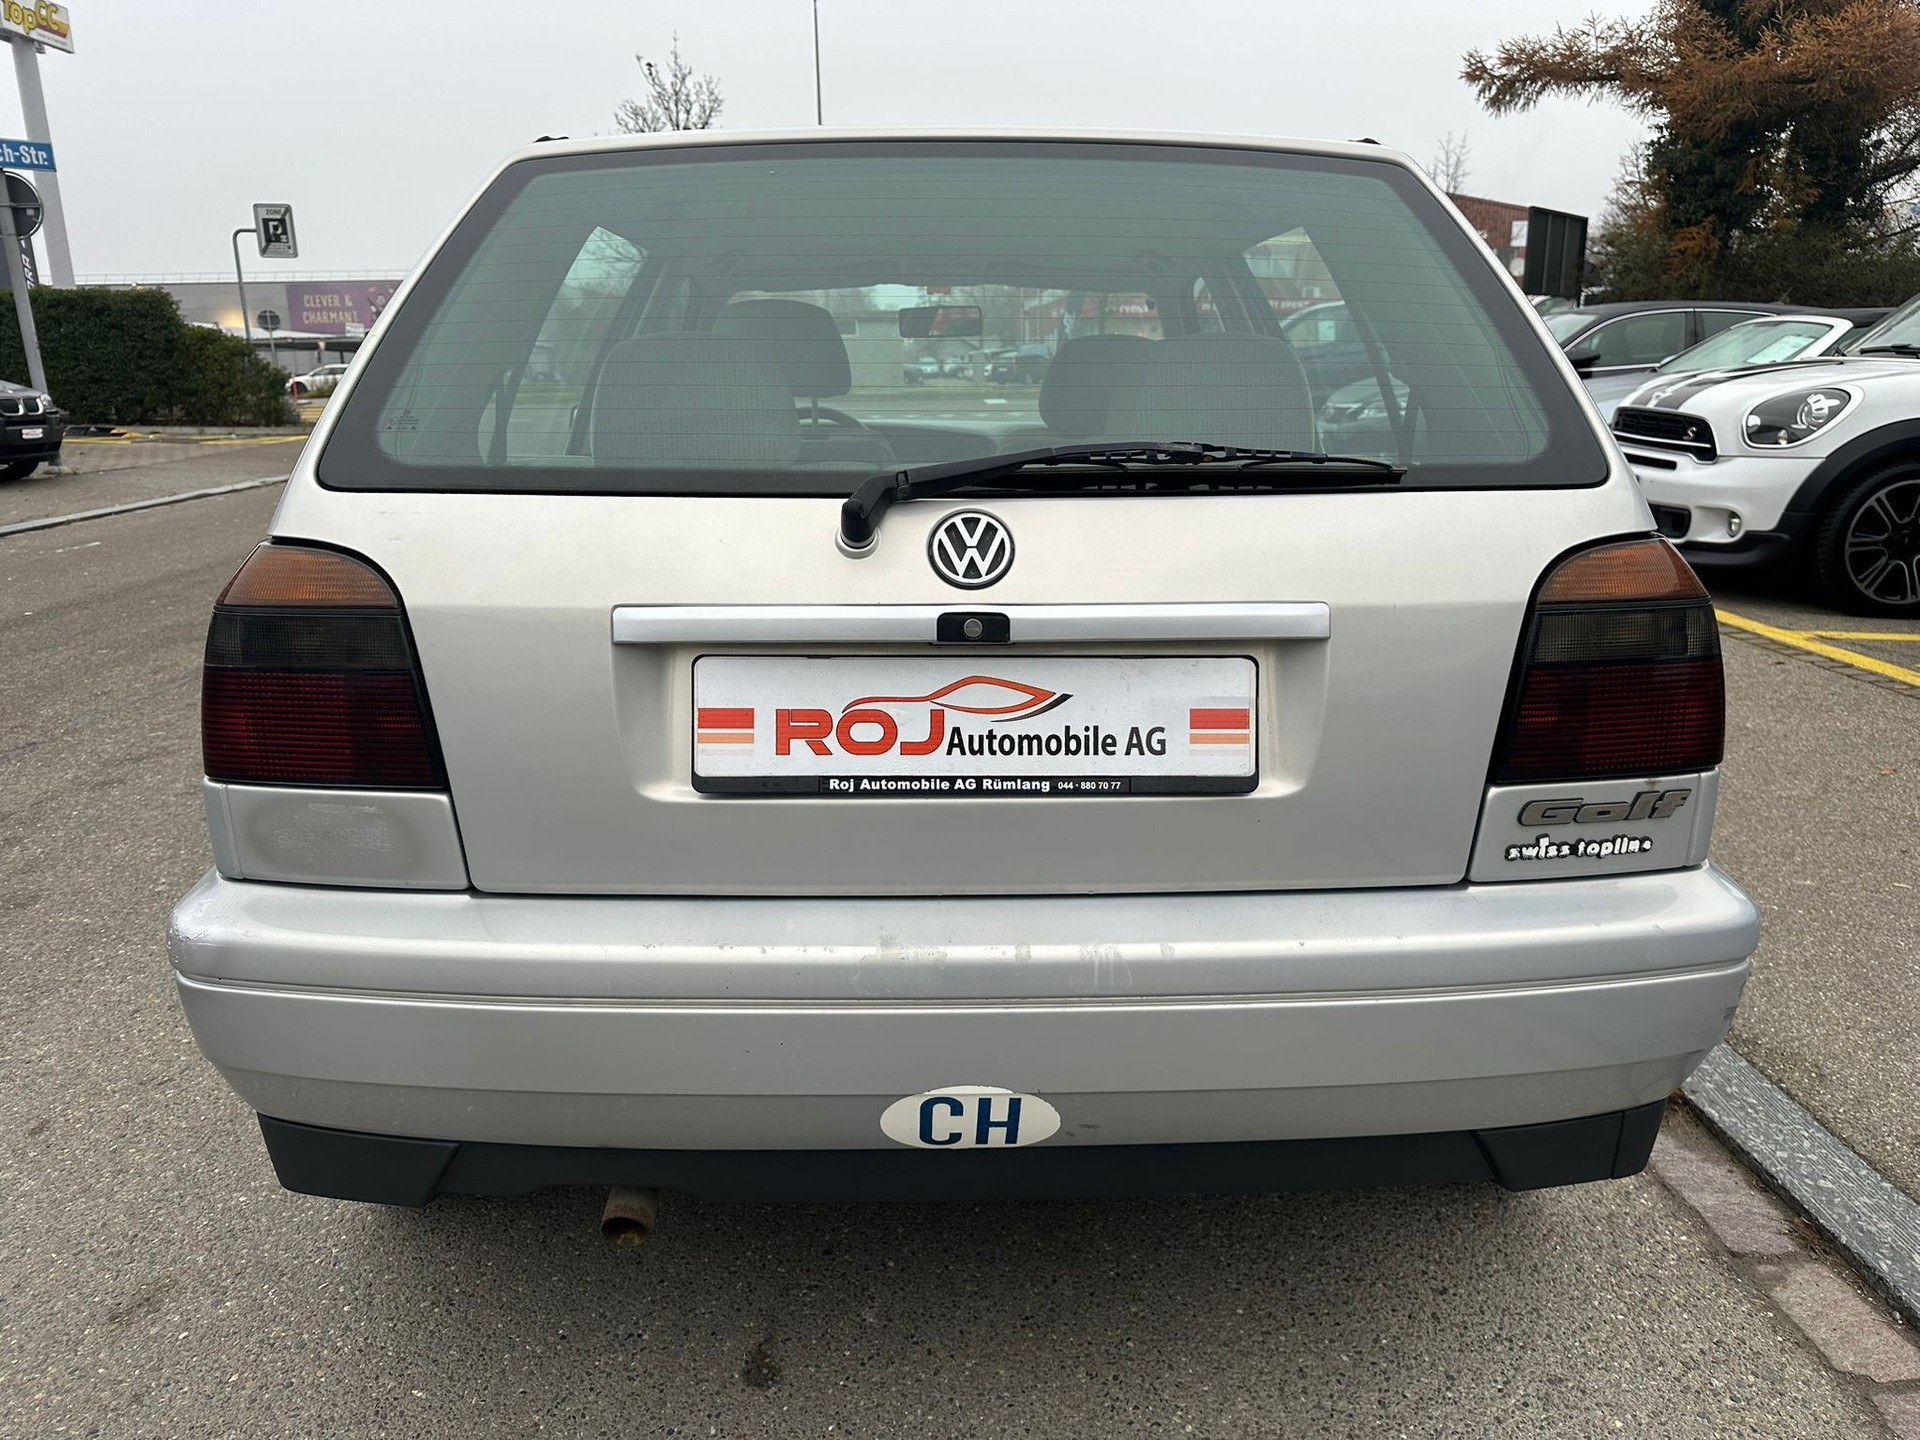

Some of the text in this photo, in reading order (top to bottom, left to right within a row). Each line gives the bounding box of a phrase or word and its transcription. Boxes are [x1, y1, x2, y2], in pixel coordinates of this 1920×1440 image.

[303, 293, 354, 307] CLEVER &
[302, 311, 358, 324] CHARMANT
[933, 513, 1011, 584] VW
[775, 709, 1167, 757] ROJ Automobile AG
[829, 778, 855, 793] Roj
[860, 778, 951, 790] Automobile
[954, 778, 977, 790] AG
[982, 778, 1051, 793] Rümlang
[1058, 781, 1074, 790] 044
[1080, 781, 1096, 790] 880
[1098, 781, 1109, 790] 70
[1110, 781, 1122, 790] 77
[1518, 789, 1692, 826] Golf
[1505, 833, 1572, 860] swiss
[919, 1096, 1022, 1146] CH
